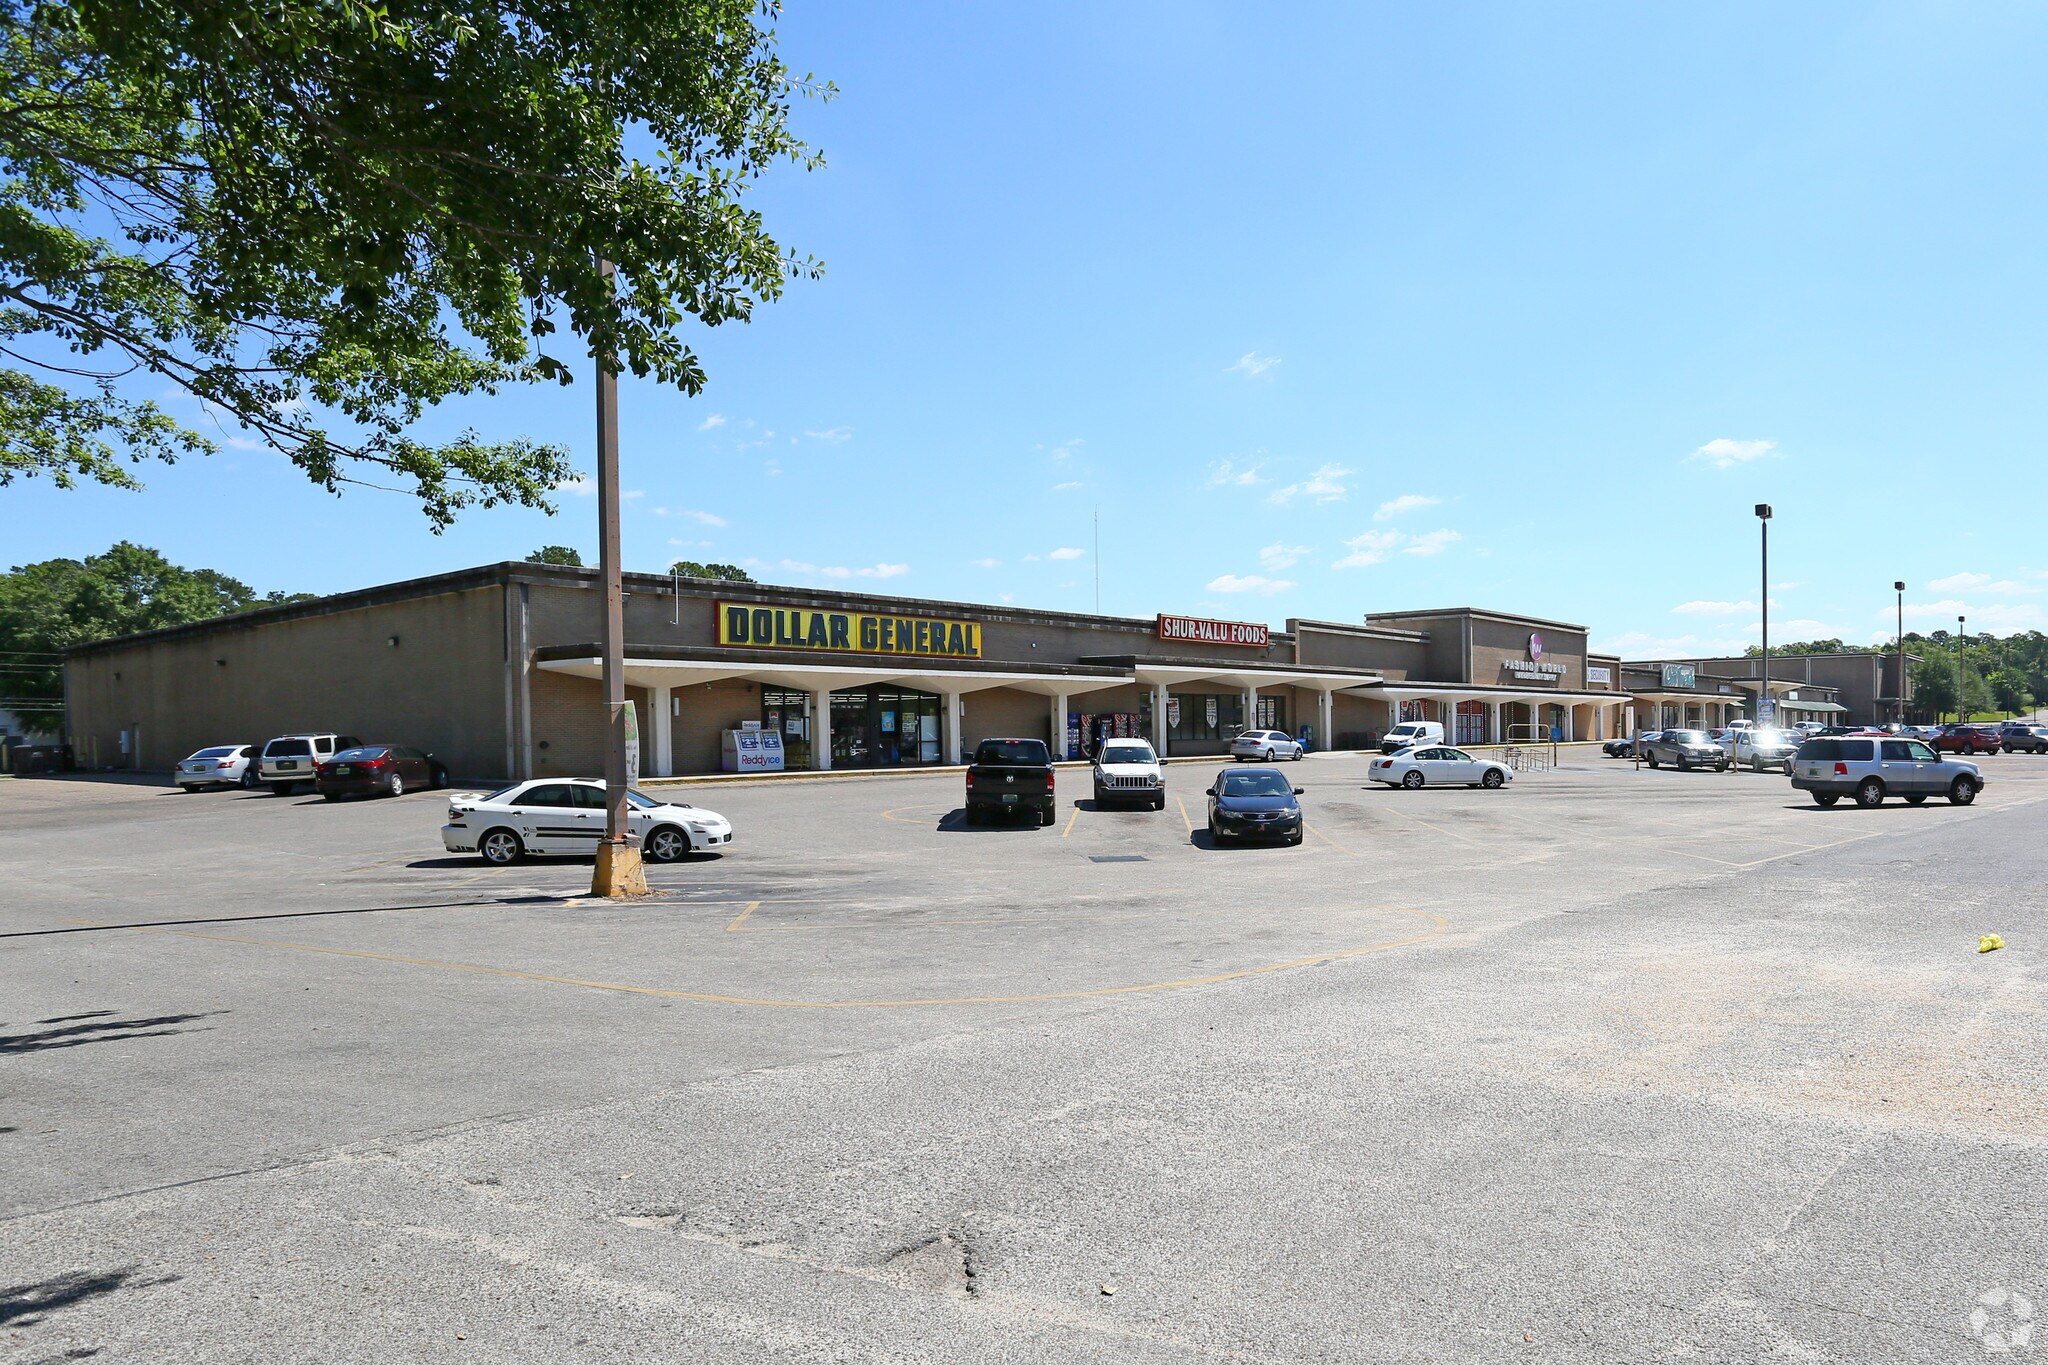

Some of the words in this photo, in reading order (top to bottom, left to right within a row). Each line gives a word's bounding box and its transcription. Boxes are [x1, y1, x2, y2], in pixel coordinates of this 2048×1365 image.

[728, 607, 850, 648] DOLLAR
[861, 617, 977, 654] GENERAL
[1164, 618, 1227, 640] SHUR-VALU
[1232, 625, 1266, 644] FOODS
[1590, 669, 1609, 681] SECURITY
